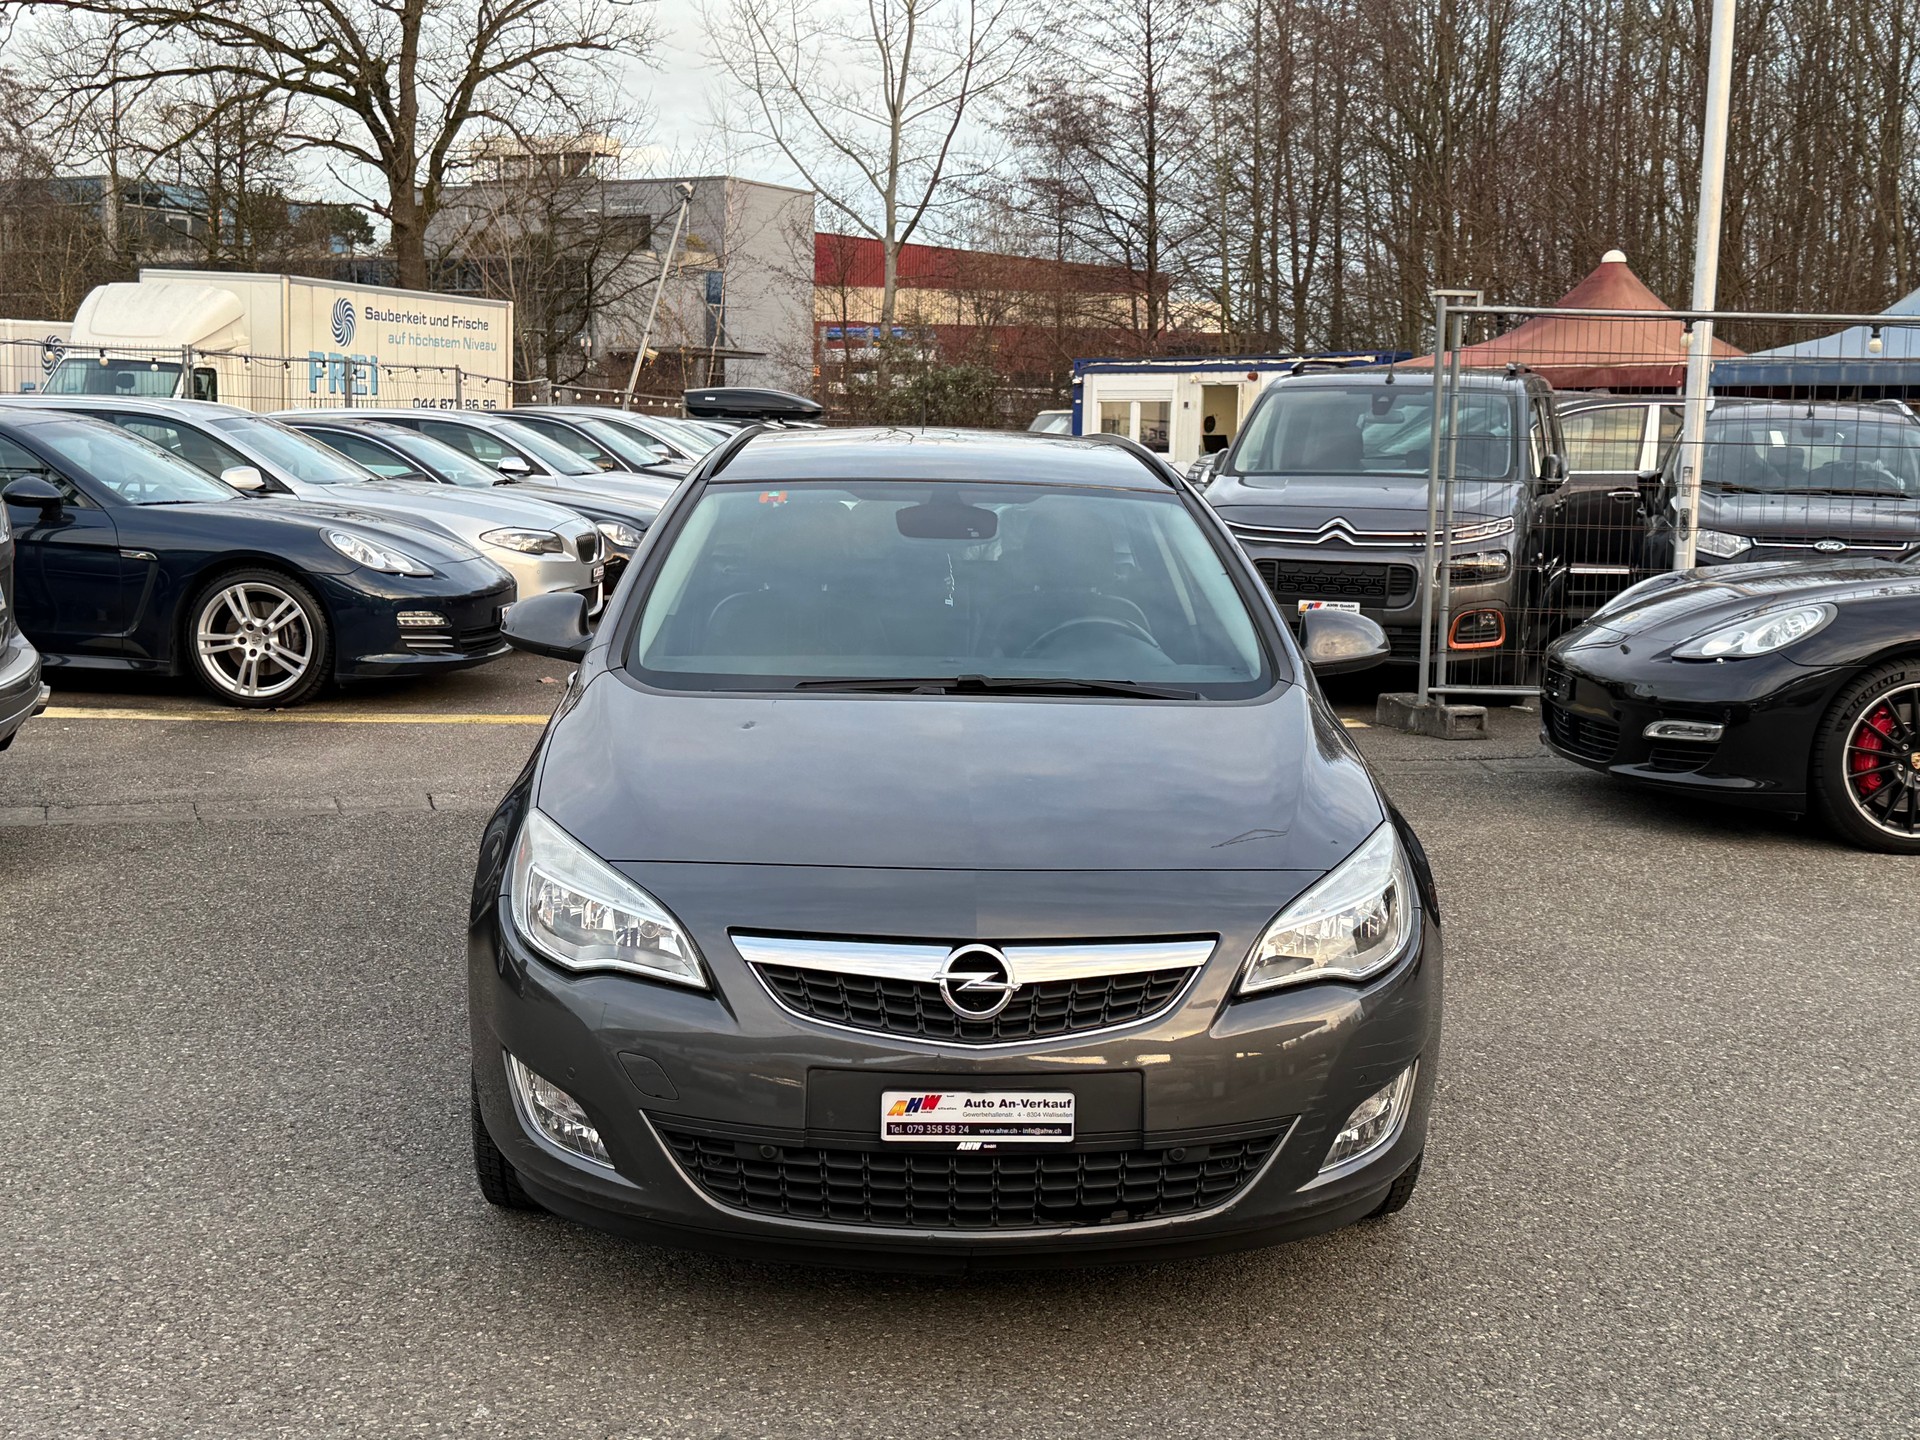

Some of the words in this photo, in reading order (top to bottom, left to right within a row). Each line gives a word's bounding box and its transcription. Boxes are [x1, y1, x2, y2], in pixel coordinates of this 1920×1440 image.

[365, 306, 427, 325] Sauberkeit
[429, 315, 449, 327] und
[452, 316, 489, 330] Frische
[388, 332, 406, 345] auf
[408, 332, 460, 348] höchstem
[463, 337, 497, 351] Niveau
[309, 351, 378, 395] FREI
[412, 398, 436, 409] 044
[1845, 672, 1903, 717] MICHELIN
[887, 1094, 943, 1117] AHW
[964, 1098, 995, 1109] Auto
[998, 1098, 1073, 1109] An-Verkauf
[890, 1124, 904, 1134] Tel.
[906, 1124, 924, 1134] 079
[926, 1124, 943, 1134] 358
[945, 1124, 956, 1134] 58
[958, 1124, 970, 1134] 24
[1022, 1127, 1062, 1135] info@ahw.ch
[956, 1142, 982, 1151] AHW
